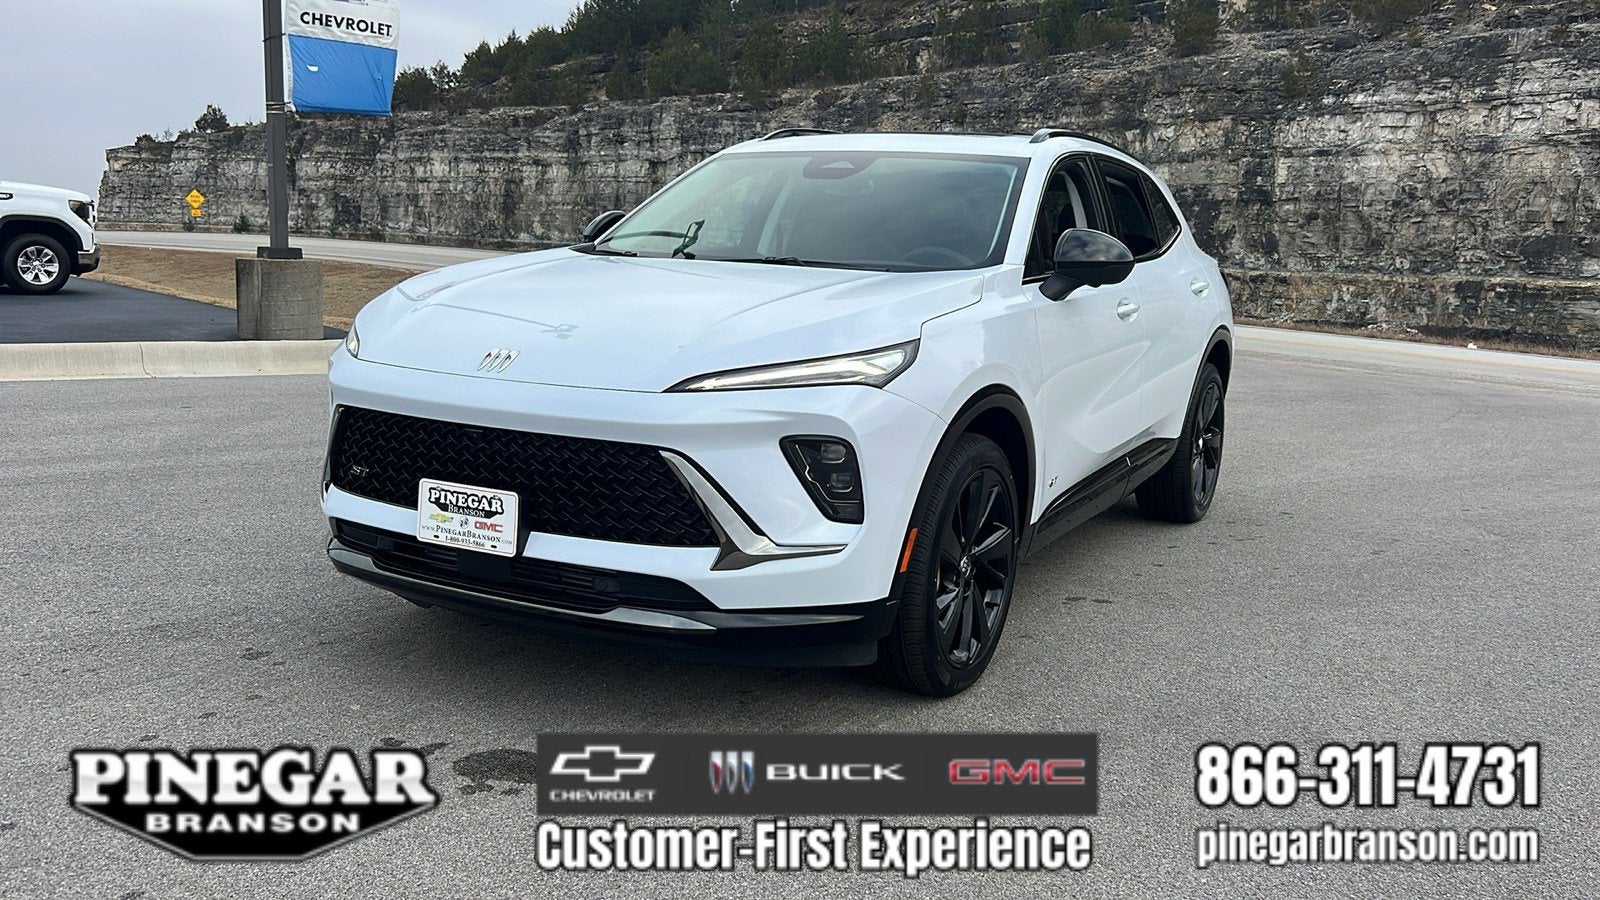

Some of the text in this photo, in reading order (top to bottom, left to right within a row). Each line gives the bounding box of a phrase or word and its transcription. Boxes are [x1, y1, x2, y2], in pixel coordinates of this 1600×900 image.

[300, 12, 392, 37] CHEVROLET
[430, 489, 503, 513] PINEGAR
[474, 520, 503, 533] GMC
